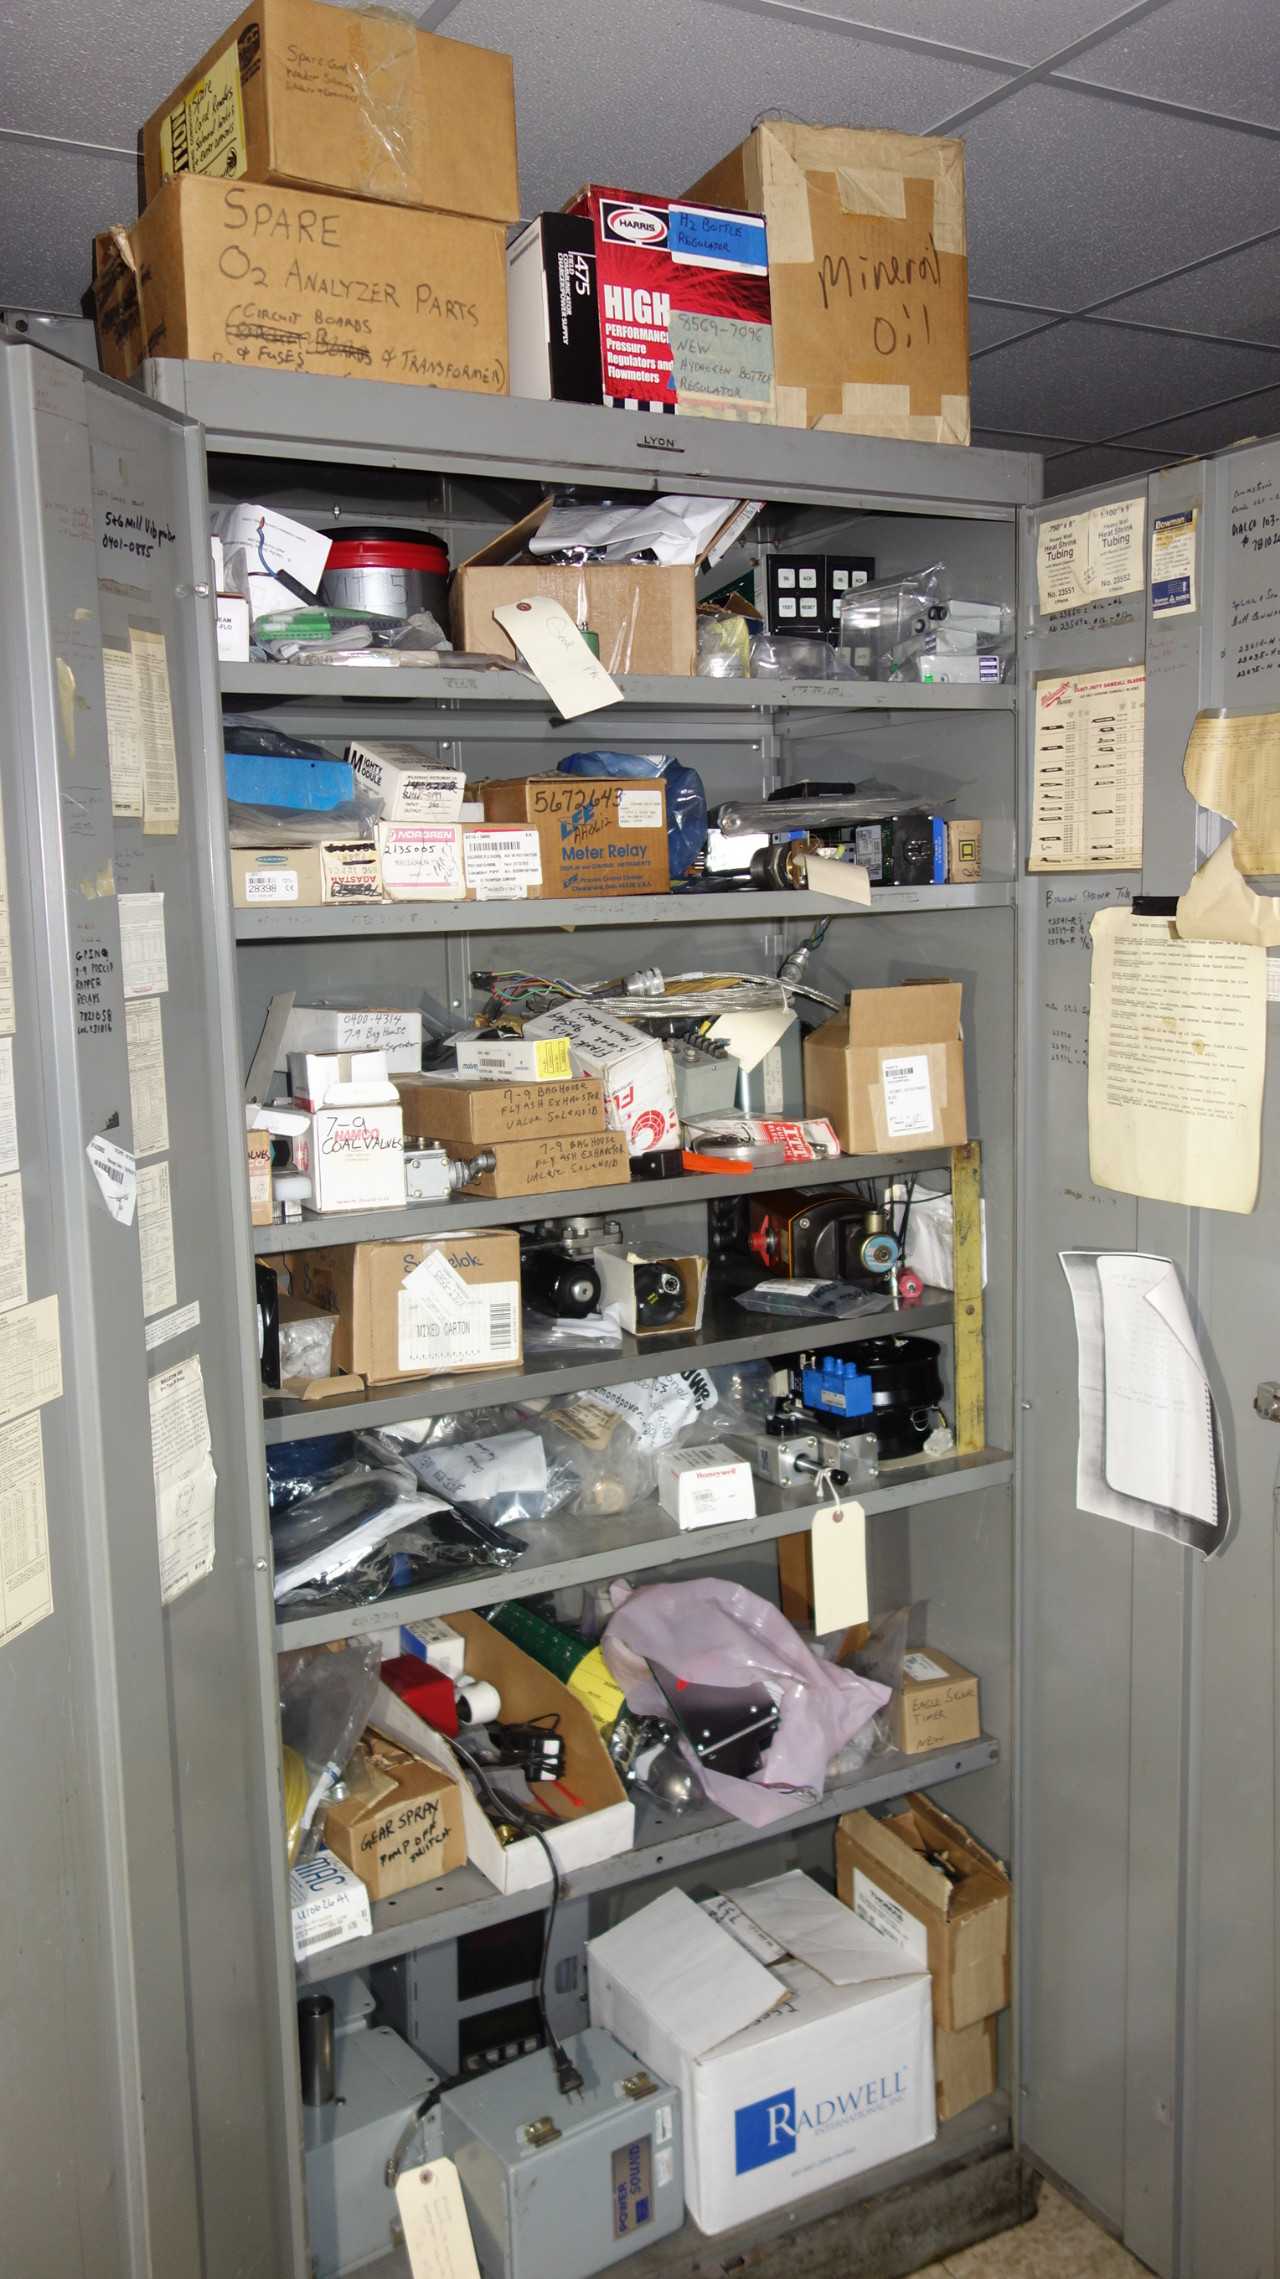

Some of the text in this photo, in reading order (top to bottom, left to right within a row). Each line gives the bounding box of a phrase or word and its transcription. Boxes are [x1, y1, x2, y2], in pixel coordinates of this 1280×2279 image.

[224, 188, 340, 248] SPARE
[618, 218, 656, 232] HARRIS
[702, 217, 744, 237] BOTTLE
[679, 232, 731, 253] REGULATOR
[574, 255, 591, 296] 475
[818, 231, 942, 310] Mineral
[219, 245, 480, 327] O2 ANALYZER PARTS
[603, 283, 671, 327] HIGH
[314, 310, 372, 334] BOARDS
[873, 303, 931, 356] Oil
[606, 337, 647, 355] Pressure
[677, 339, 709, 355] NEW
[257, 349, 305, 367] FUSES
[606, 351, 673, 372] Regulators and
[607, 365, 660, 384] Flowmeters
[680, 376, 742, 399] REGULATOR
[644, 435, 674, 448] LYON
[1098, 525, 1133, 539] Heat Shrink
[1101, 533, 1130, 548] Tubing
[1044, 538, 1077, 551] Heat Shrink
[1046, 548, 1074, 561] Tubing
[561, 844, 649, 861] Meter Relay
[321, 1136, 361, 1155] COAL
[403, 1251, 484, 1273] Selok
[416, 1320, 471, 1338] MIXED CARTON
[696, 1467, 737, 1480] Honeywell
[360, 1799, 441, 1852] GEAR SPRAY
[767, 2070, 908, 2148] RADWELL
[629, 2143, 641, 2195] SOUND
[617, 2183, 628, 2233] POWER
